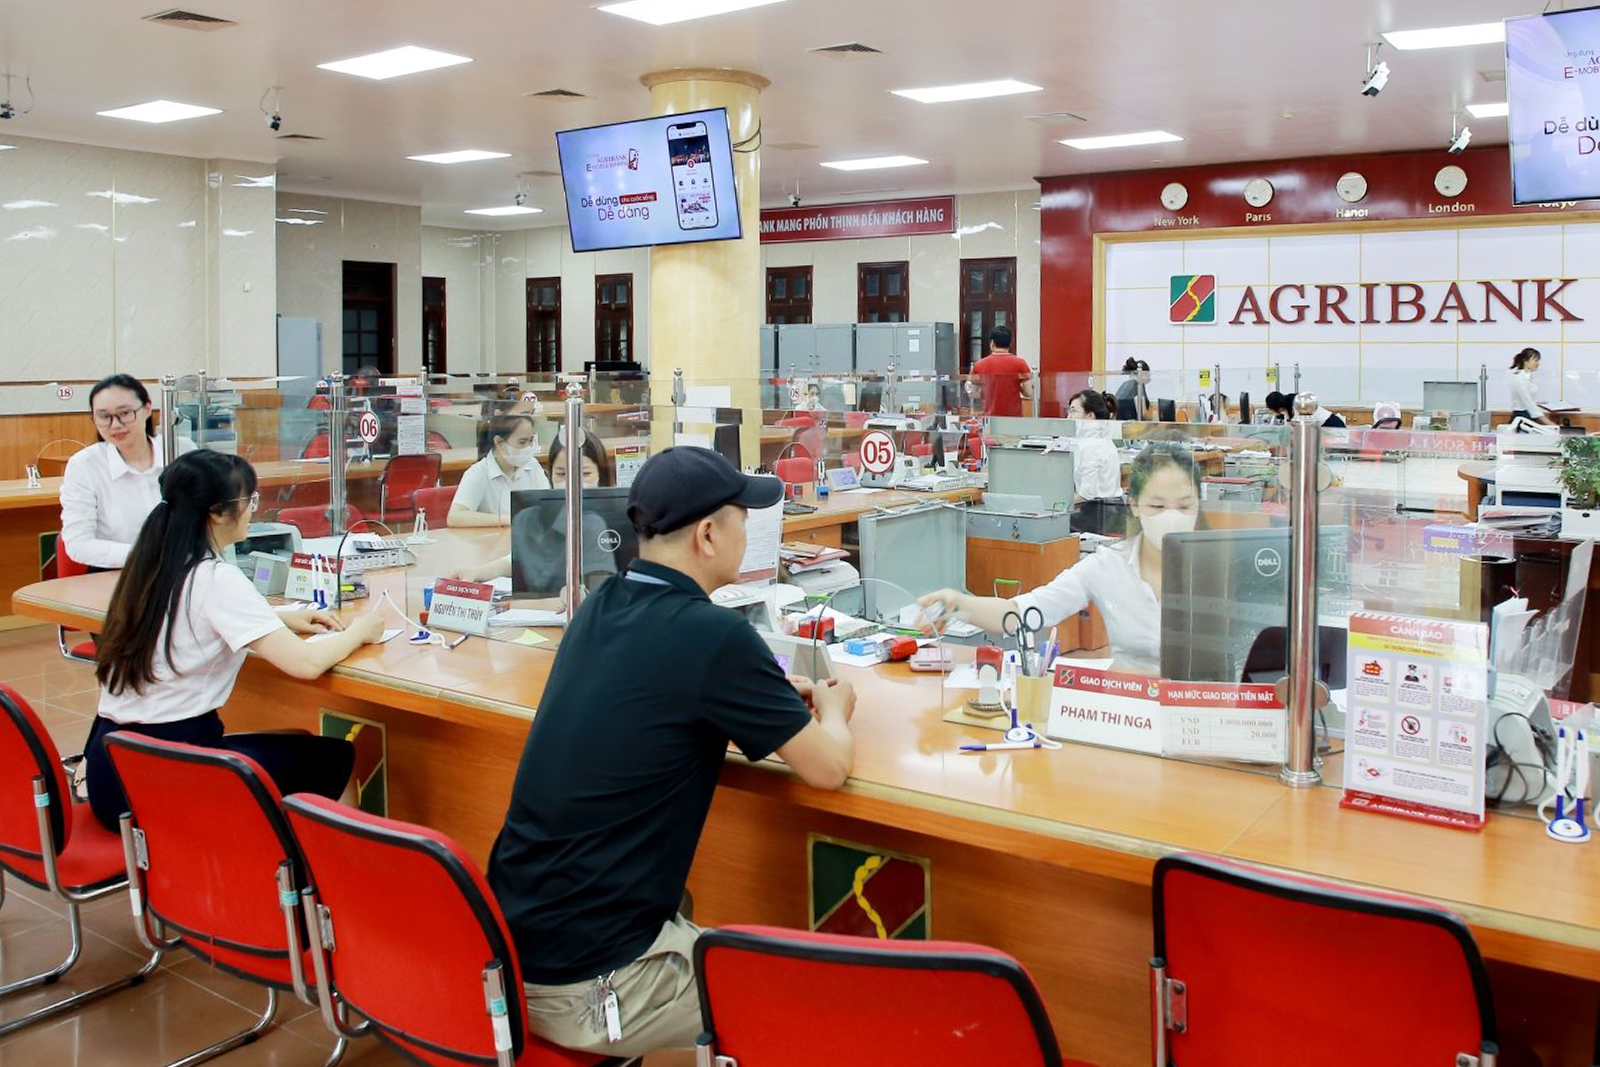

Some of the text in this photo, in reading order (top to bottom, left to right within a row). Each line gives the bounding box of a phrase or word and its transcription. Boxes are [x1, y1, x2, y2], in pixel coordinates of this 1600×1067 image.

[1428, 201, 1475, 213] London
[776, 219, 802, 232] MANG
[830, 214, 859, 231] THỊNH
[861, 209, 881, 227] ĐẾN
[882, 208, 914, 226] KHÁCH
[915, 206, 944, 223] HÀNG
[1154, 215, 1200, 226] New York
[1245, 212, 1272, 222] Paris
[1228, 279, 1585, 325] AGRIBANK
[60, 388, 71, 397] 18
[361, 418, 377, 437] 06
[863, 440, 891, 464] 05
[1257, 558, 1278, 566] DELL
[1080, 676, 1142, 691] GIAO DỊCH VIÊN
[1168, 690, 1184, 701] HẠN
[1202, 691, 1220, 700] GIAO
[1221, 691, 1239, 702] DỊCH
[1060, 705, 1098, 722] PHẠM
[1124, 715, 1152, 729] NGA
